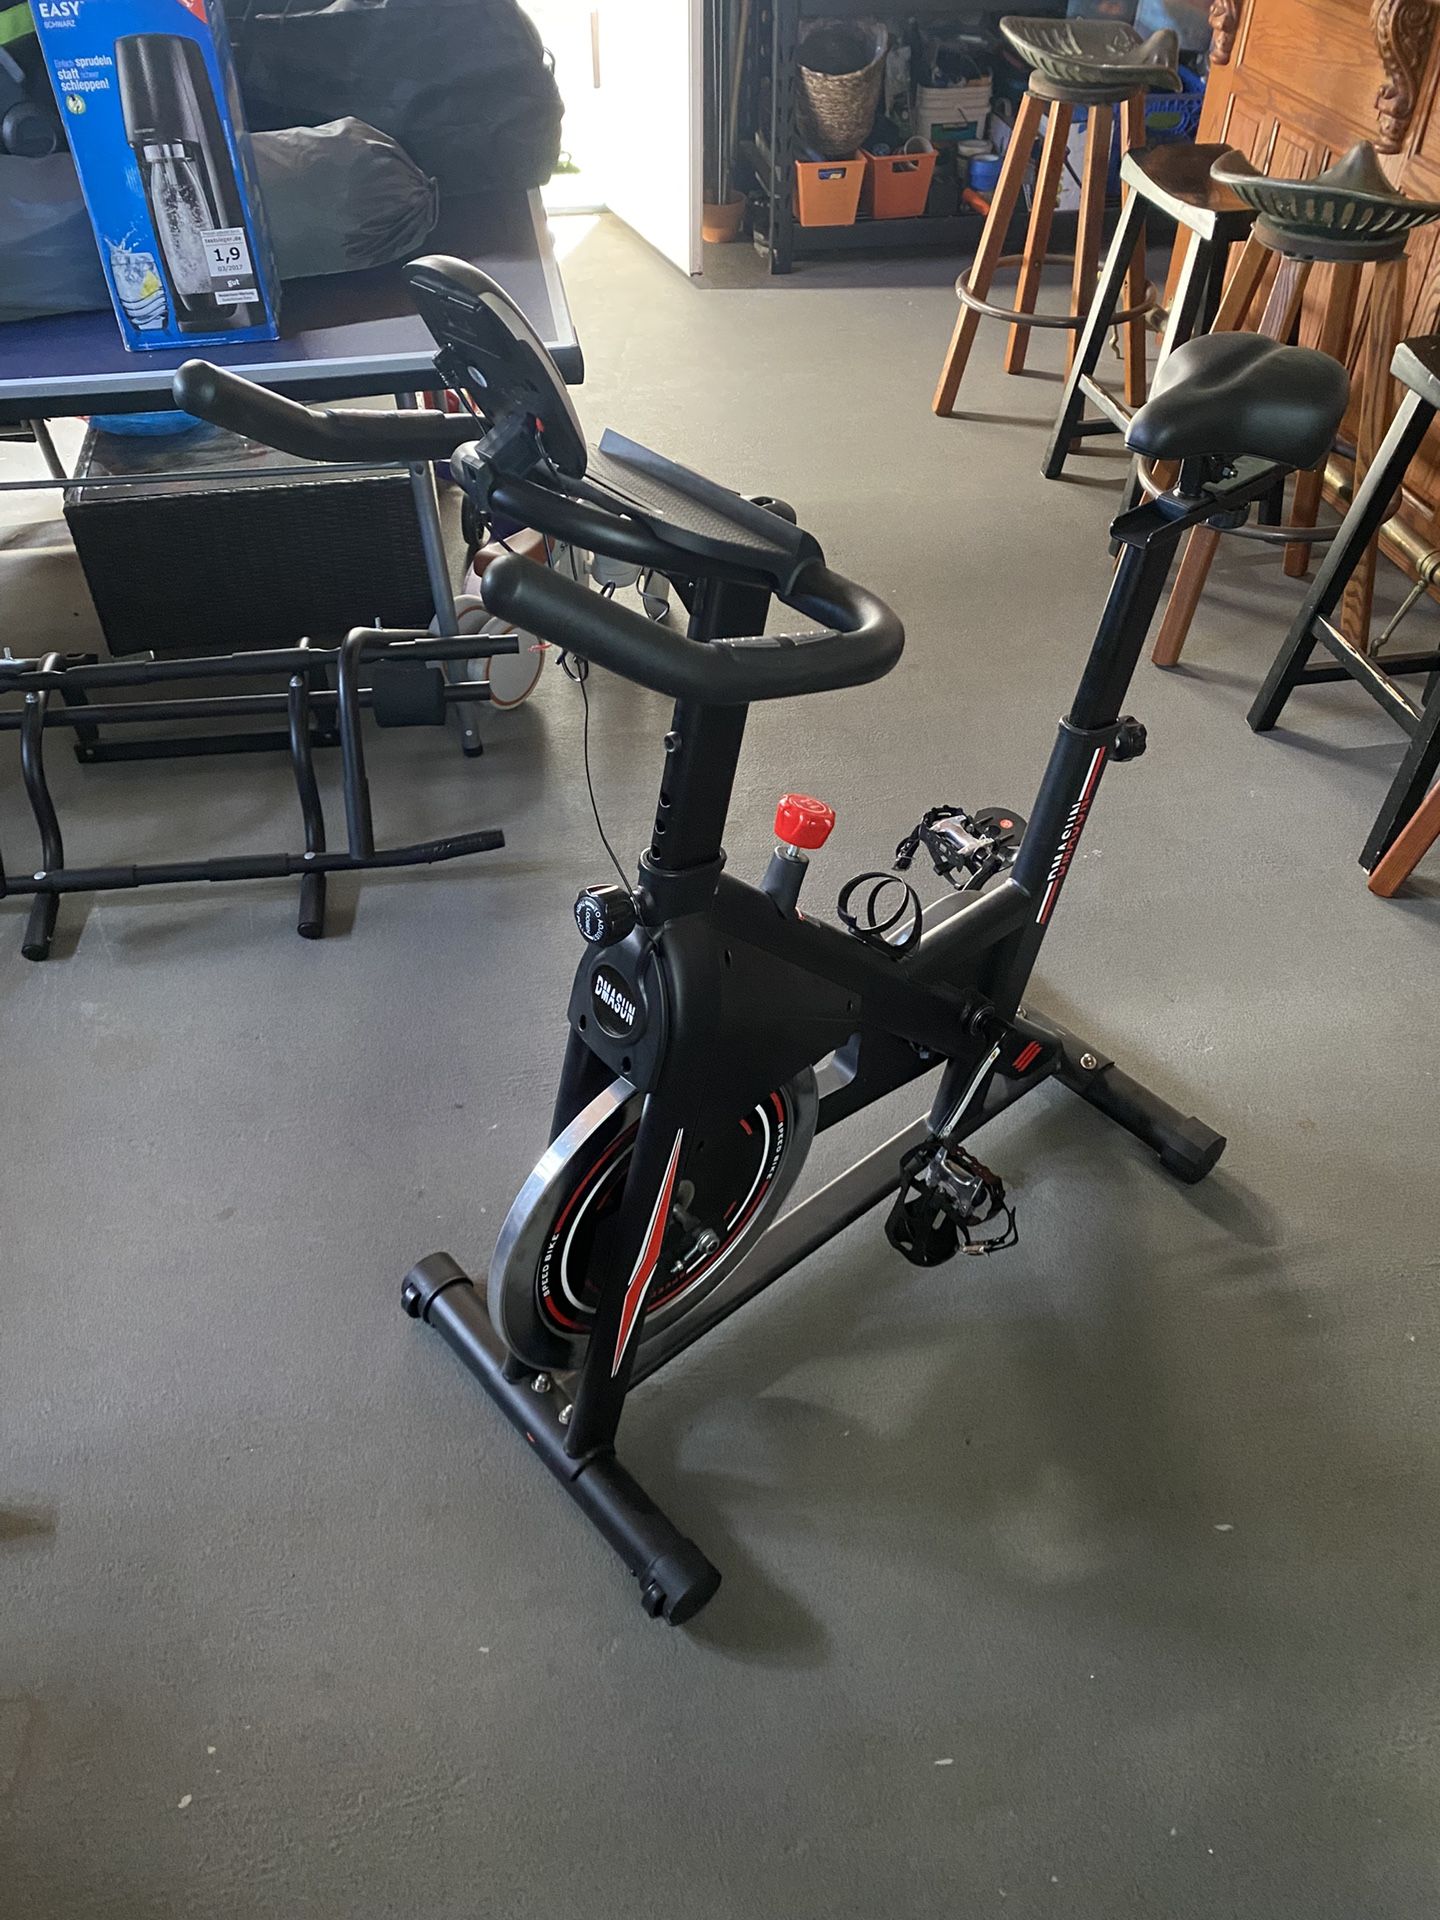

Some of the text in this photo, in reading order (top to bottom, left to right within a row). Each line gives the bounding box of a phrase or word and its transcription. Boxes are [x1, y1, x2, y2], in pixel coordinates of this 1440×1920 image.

[39, 1, 79, 17] EASY
[43, 20, 76, 29] SCHWARZ
[75, 55, 112, 68] sprudeln
[57, 68, 80, 80] statt
[61, 78, 110, 91] schleppen!
[213, 247, 240, 263] 1,9
[227, 279, 240, 288] gut
[594, 974, 636, 1026] DMASUN
[541, 1233, 559, 1297] SPEED BIKE
